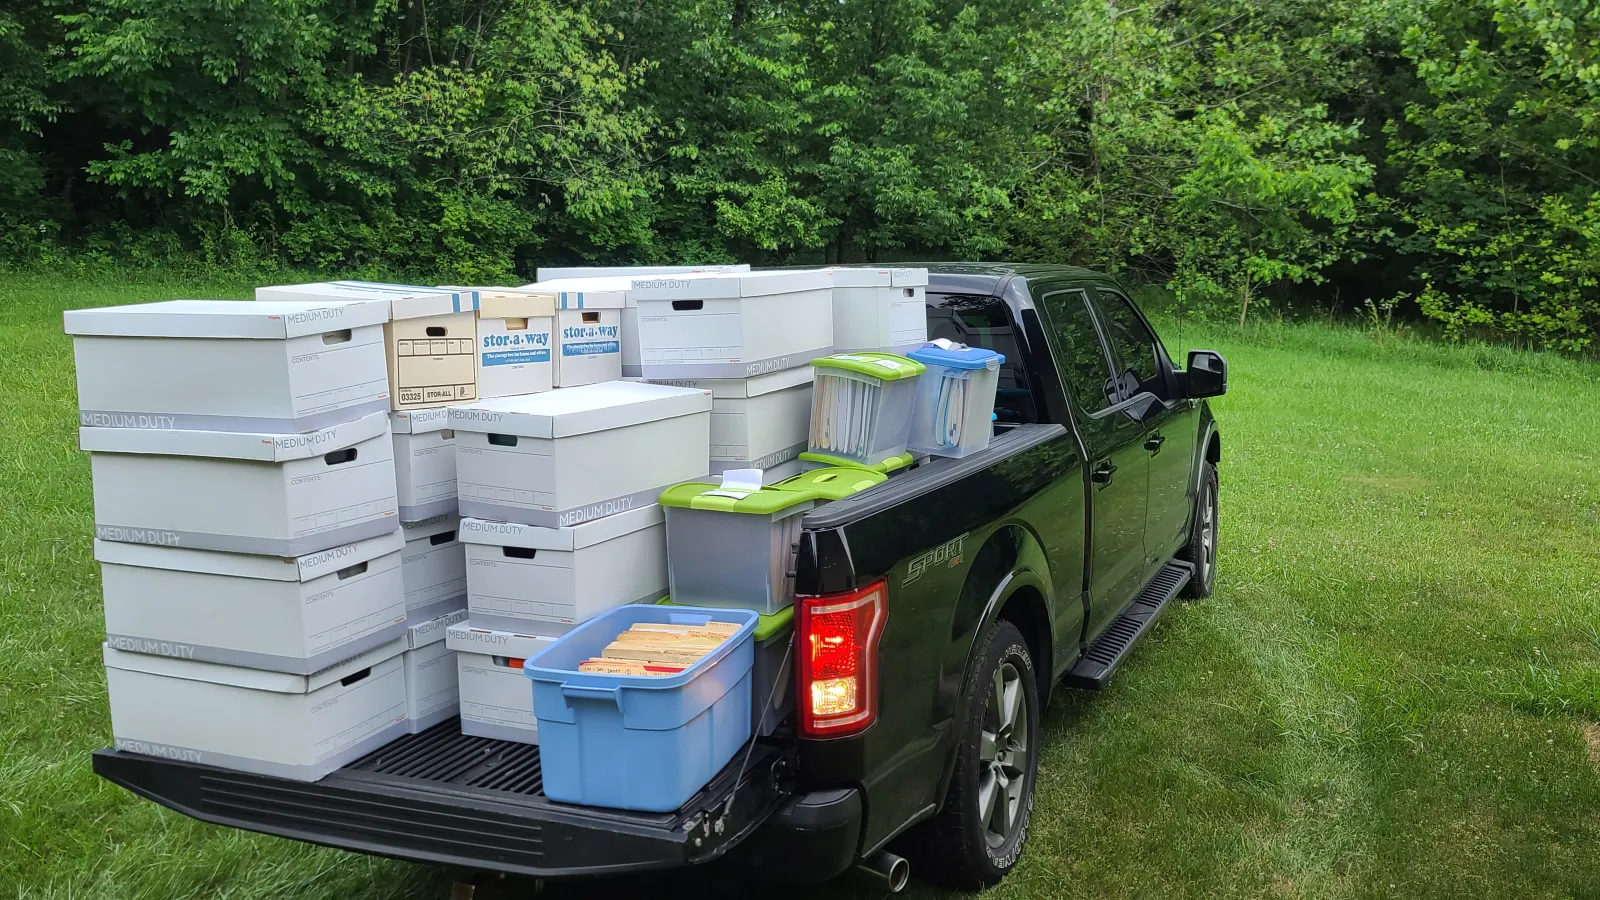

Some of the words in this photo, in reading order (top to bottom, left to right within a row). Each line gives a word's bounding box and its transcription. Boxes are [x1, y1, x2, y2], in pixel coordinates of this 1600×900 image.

[633, 280, 667, 289] MEDIUM
[668, 280, 691, 289] DUTY
[287, 311, 321, 325] MEDIUM
[322, 308, 344, 320] DUTY
[746, 360, 773, 377] MEDIUM
[773, 356, 790, 371] DUTY
[675, 380, 698, 388] DUTY
[401, 392, 422, 402] 03325
[81, 413, 137, 428] MEDIUM
[138, 415, 175, 429] DUTY
[412, 411, 441, 423] MEDIUM
[447, 410, 480, 421] MEDIUM
[481, 412, 503, 422] DUTY
[275, 436, 314, 450] MEDIUM
[560, 503, 603, 526] MEDIUM
[605, 496, 633, 515] DUTY
[97, 526, 145, 542] MEDIUM
[147, 530, 180, 546] DUTY
[462, 521, 498, 534] MEDIUM
[499, 525, 523, 536] DUTY
[299, 551, 336, 570] MEDIUM
[336, 543, 358, 559] DUTY
[901, 531, 970, 588] SPORT
[415, 619, 444, 637] MEDIUM
[445, 611, 463, 627] DUTY
[448, 630, 483, 642] MEDIUM
[484, 634, 508, 645] DUTY
[108, 636, 158, 655] MEDIUM
[161, 642, 194, 659] DUTY
[116, 739, 165, 758] MEDIUM
[168, 747, 203, 763] DUTY
